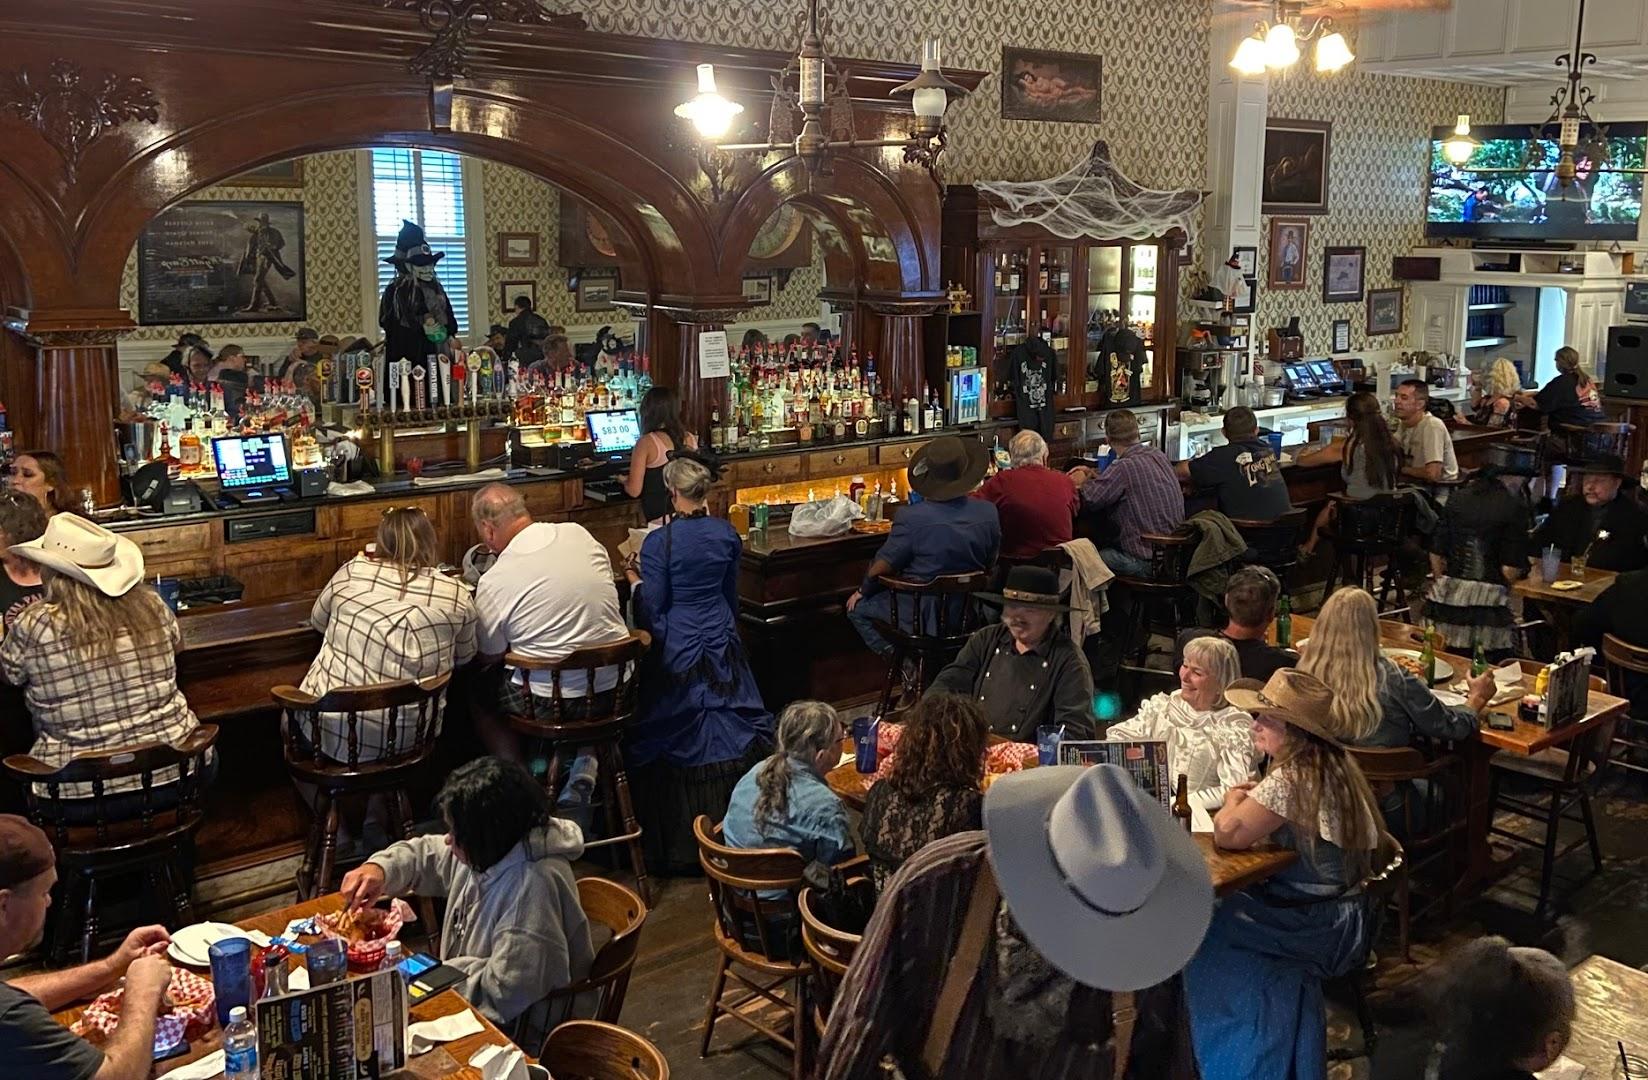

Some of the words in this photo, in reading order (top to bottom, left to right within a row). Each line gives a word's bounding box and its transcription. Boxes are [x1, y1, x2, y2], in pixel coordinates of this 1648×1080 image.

[430, 361, 438, 383] LIGHT
[601, 425, 630, 436] $8300
[1159, 764, 1167, 785] HOUSE
